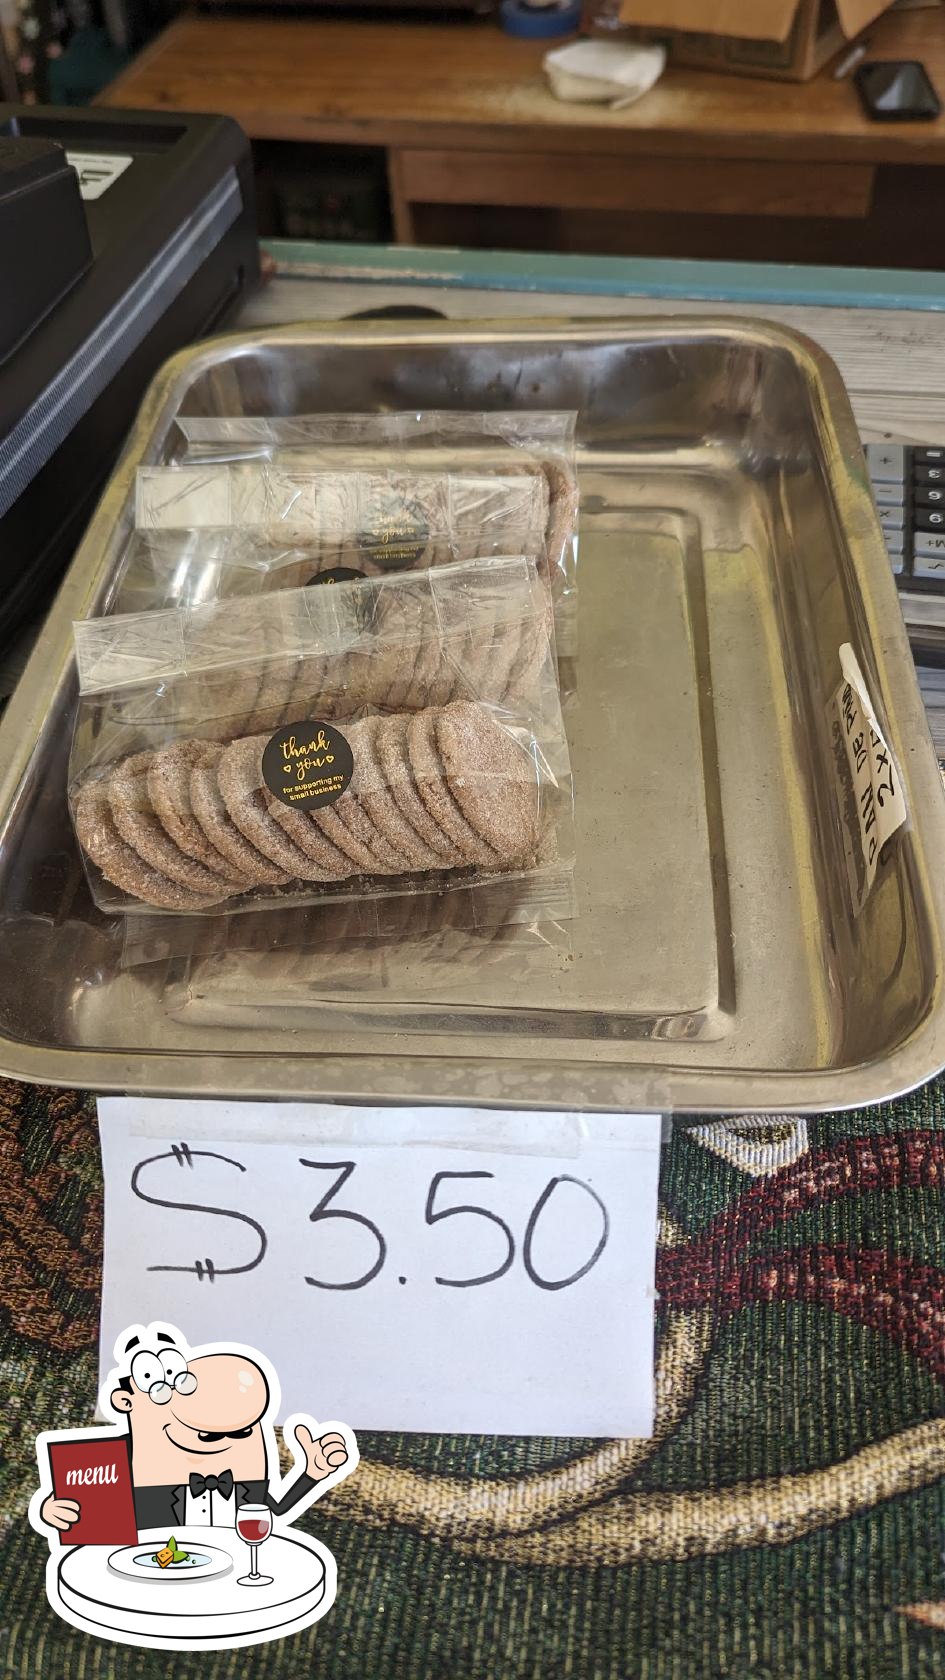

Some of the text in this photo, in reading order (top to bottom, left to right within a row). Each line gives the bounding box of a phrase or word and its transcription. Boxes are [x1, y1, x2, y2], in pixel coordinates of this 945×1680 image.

[279, 730, 331, 759] thank
[852, 731, 868, 775] DE
[296, 758, 326, 781] you
[282, 774, 344, 794] for supporting my
[289, 783, 342, 801] small business
[131, 1142, 611, 1291] $3.50
